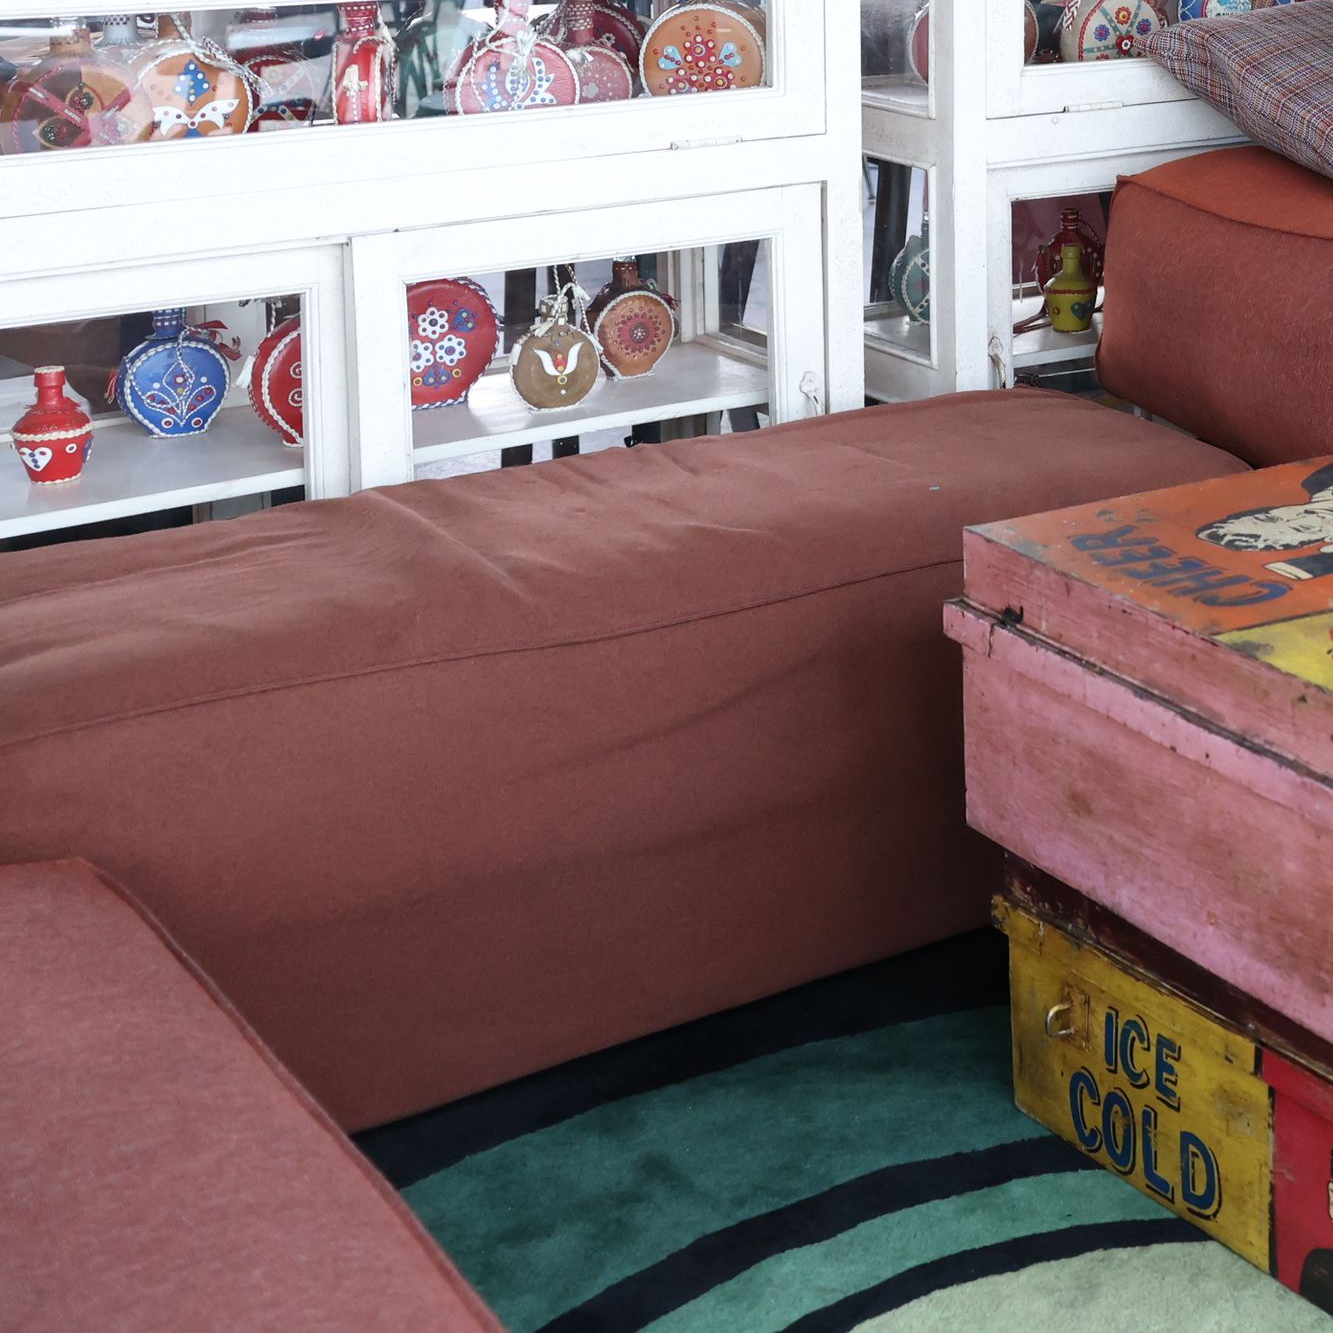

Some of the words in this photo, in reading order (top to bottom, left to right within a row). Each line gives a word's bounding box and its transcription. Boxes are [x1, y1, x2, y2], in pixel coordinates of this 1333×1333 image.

[1069, 524, 1293, 607] CHEER
[1103, 1005, 1181, 1113] ICE
[1068, 1065, 1223, 1221] COLD
